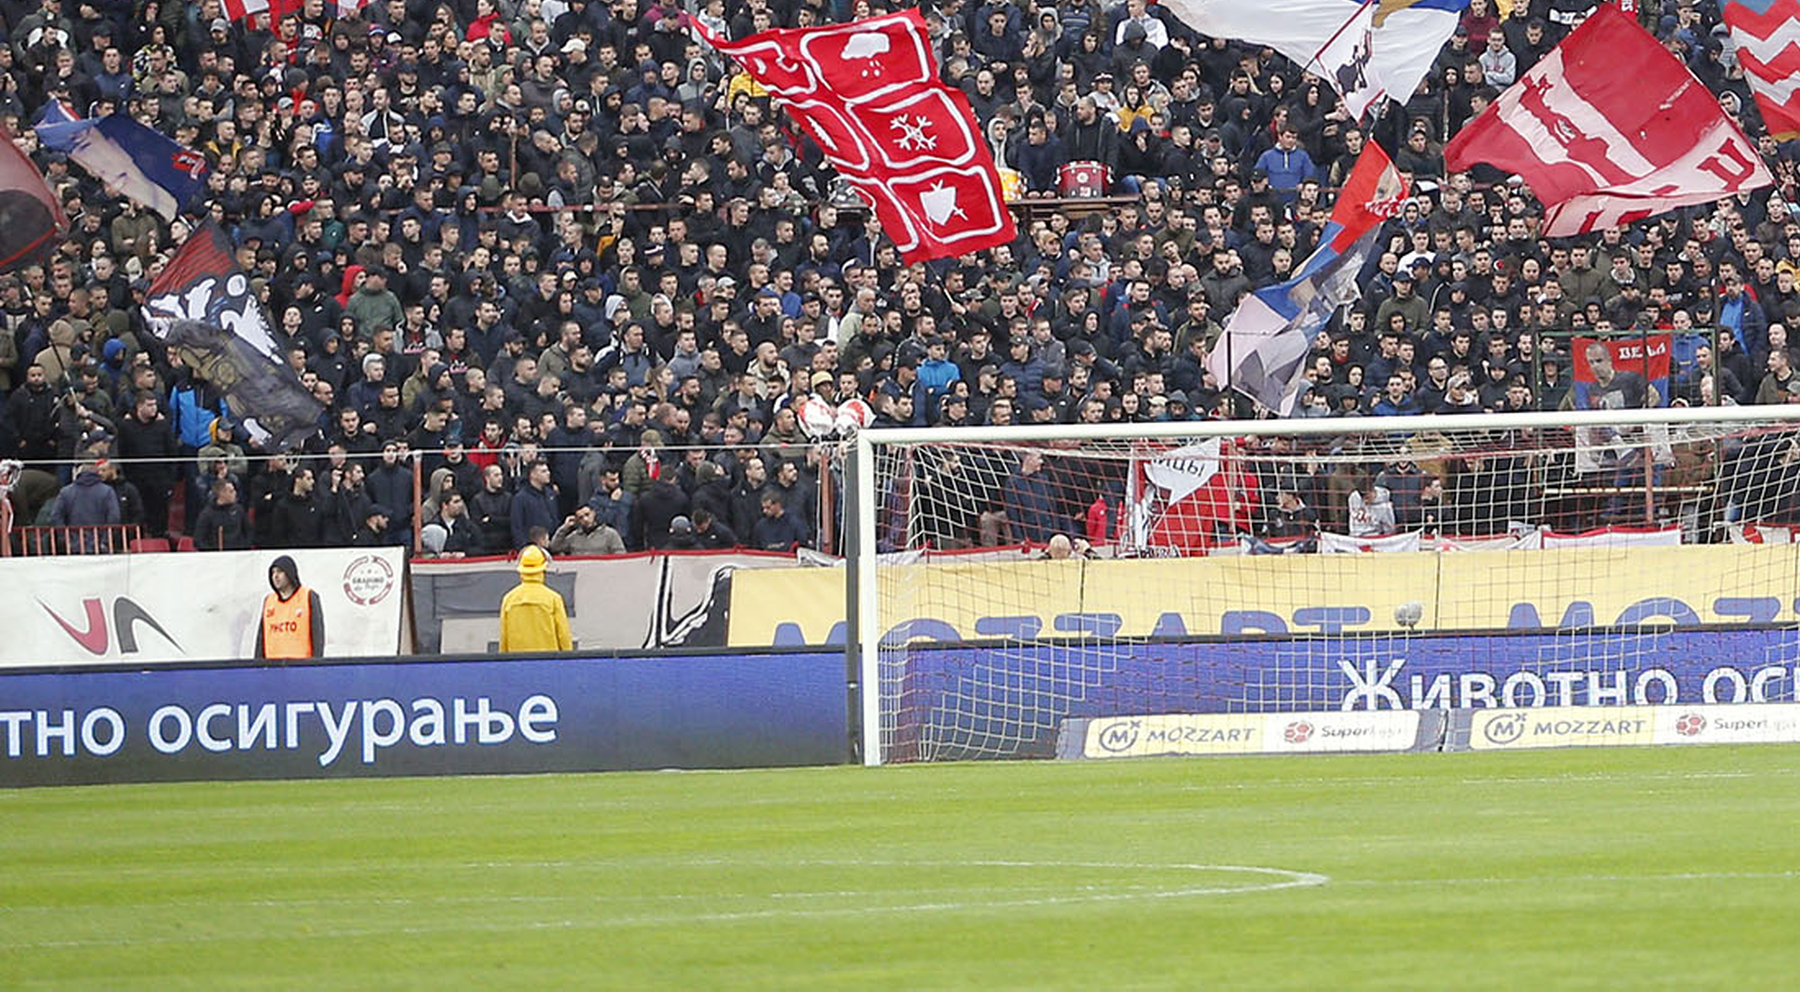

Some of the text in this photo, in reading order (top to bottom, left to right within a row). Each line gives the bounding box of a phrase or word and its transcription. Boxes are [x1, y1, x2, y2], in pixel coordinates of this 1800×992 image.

[1338, 658, 1680, 712] Животно
[148, 693, 559, 767] осигурање
[1146, 726, 1256, 743] MOZZART
[1533, 719, 1647, 735] MOZZART
